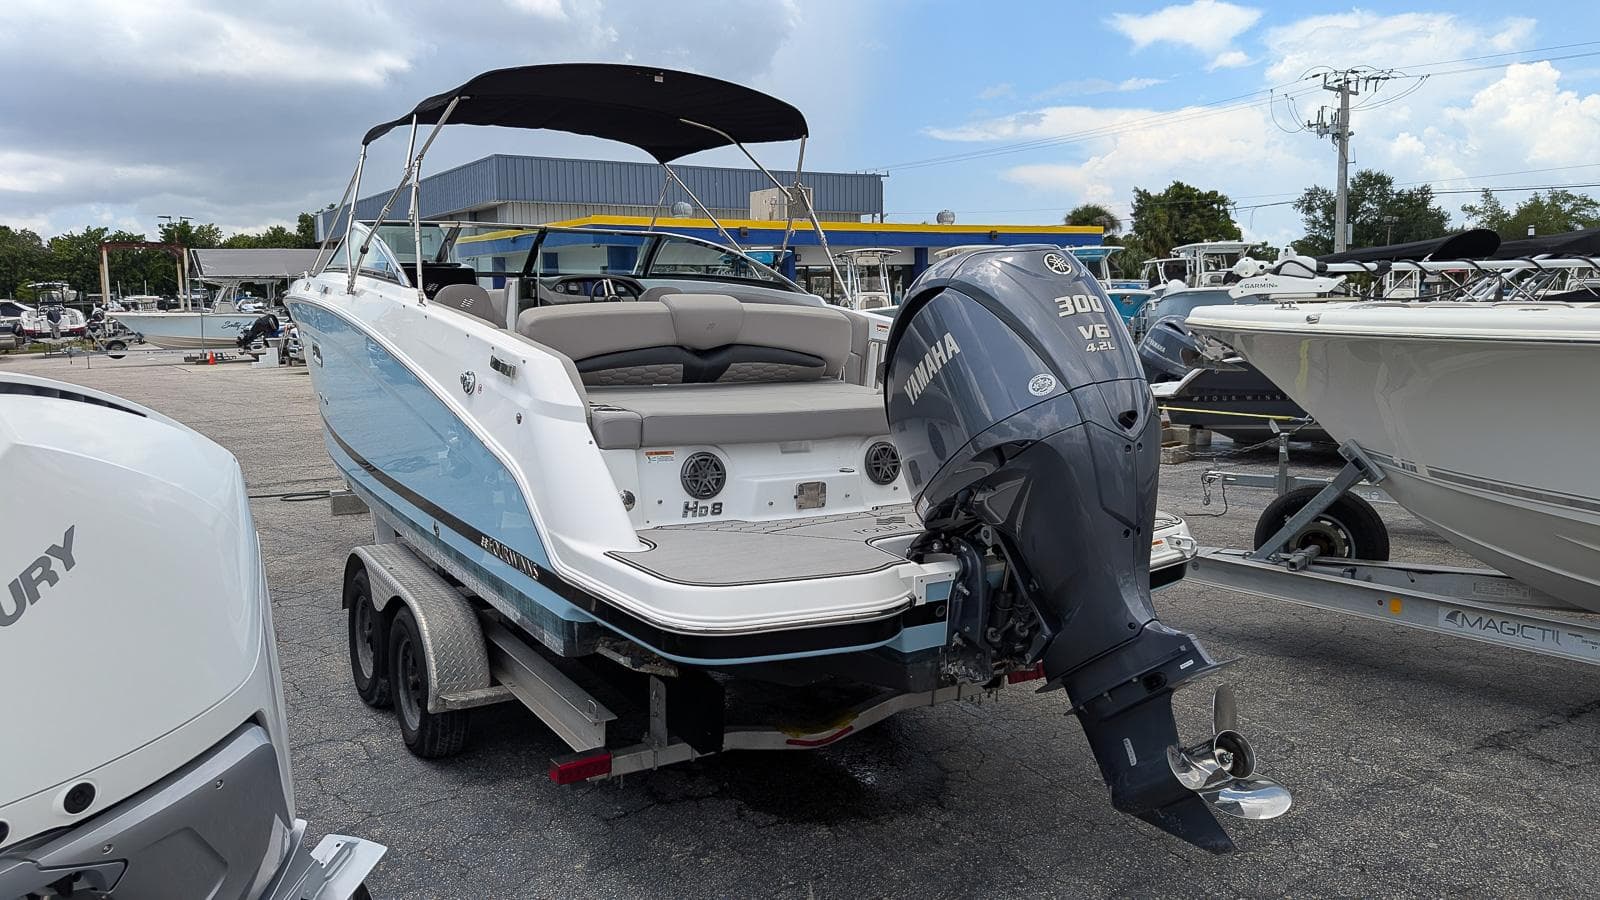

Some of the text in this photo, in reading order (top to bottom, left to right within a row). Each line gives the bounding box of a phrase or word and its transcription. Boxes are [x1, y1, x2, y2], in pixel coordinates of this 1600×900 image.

[1054, 294, 1106, 317] 300
[1077, 324, 1111, 340] V6
[1086, 341, 1116, 352] 4.2L
[903, 332, 961, 406] YAMAHA
[0, 524, 76, 627] URY
